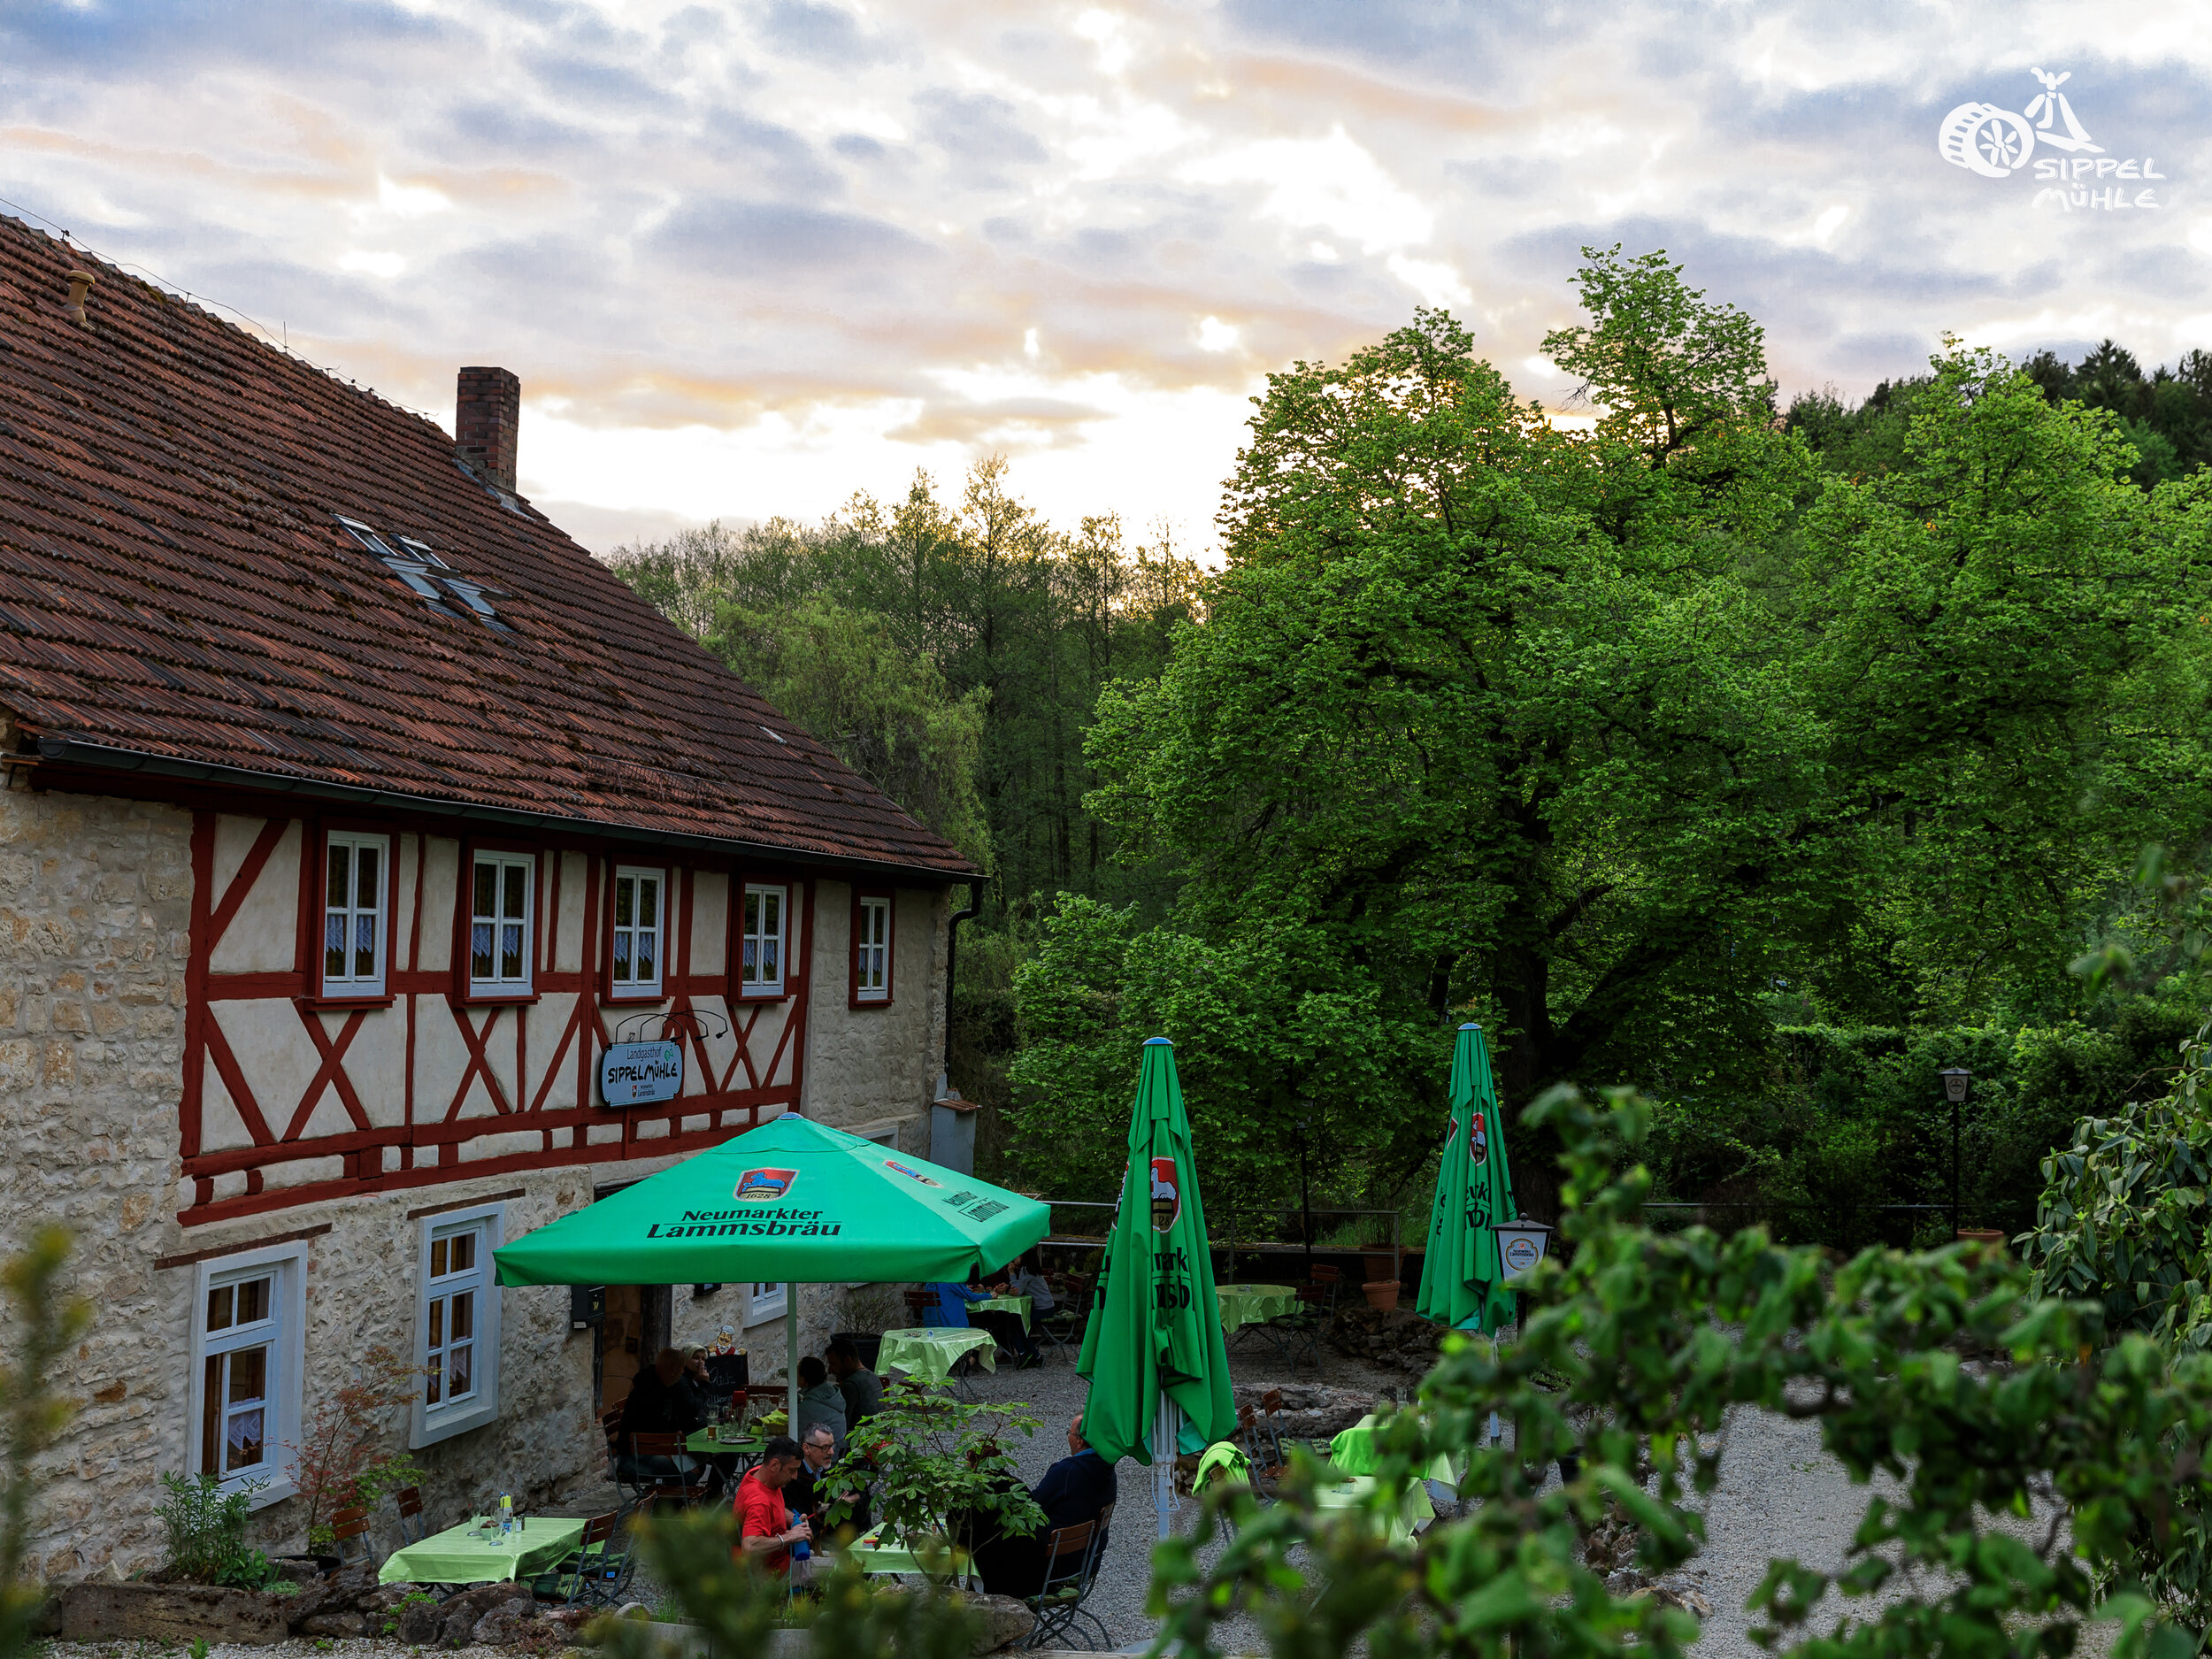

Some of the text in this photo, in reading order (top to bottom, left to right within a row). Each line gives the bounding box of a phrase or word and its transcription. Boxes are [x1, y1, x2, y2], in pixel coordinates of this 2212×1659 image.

[626, 1047, 663, 1062] Landgasthof
[608, 1060, 678, 1084] SIPPELMÜHLE
[681, 1208, 823, 1221] Neumarkter
[647, 1220, 841, 1239] Lammsbräu
